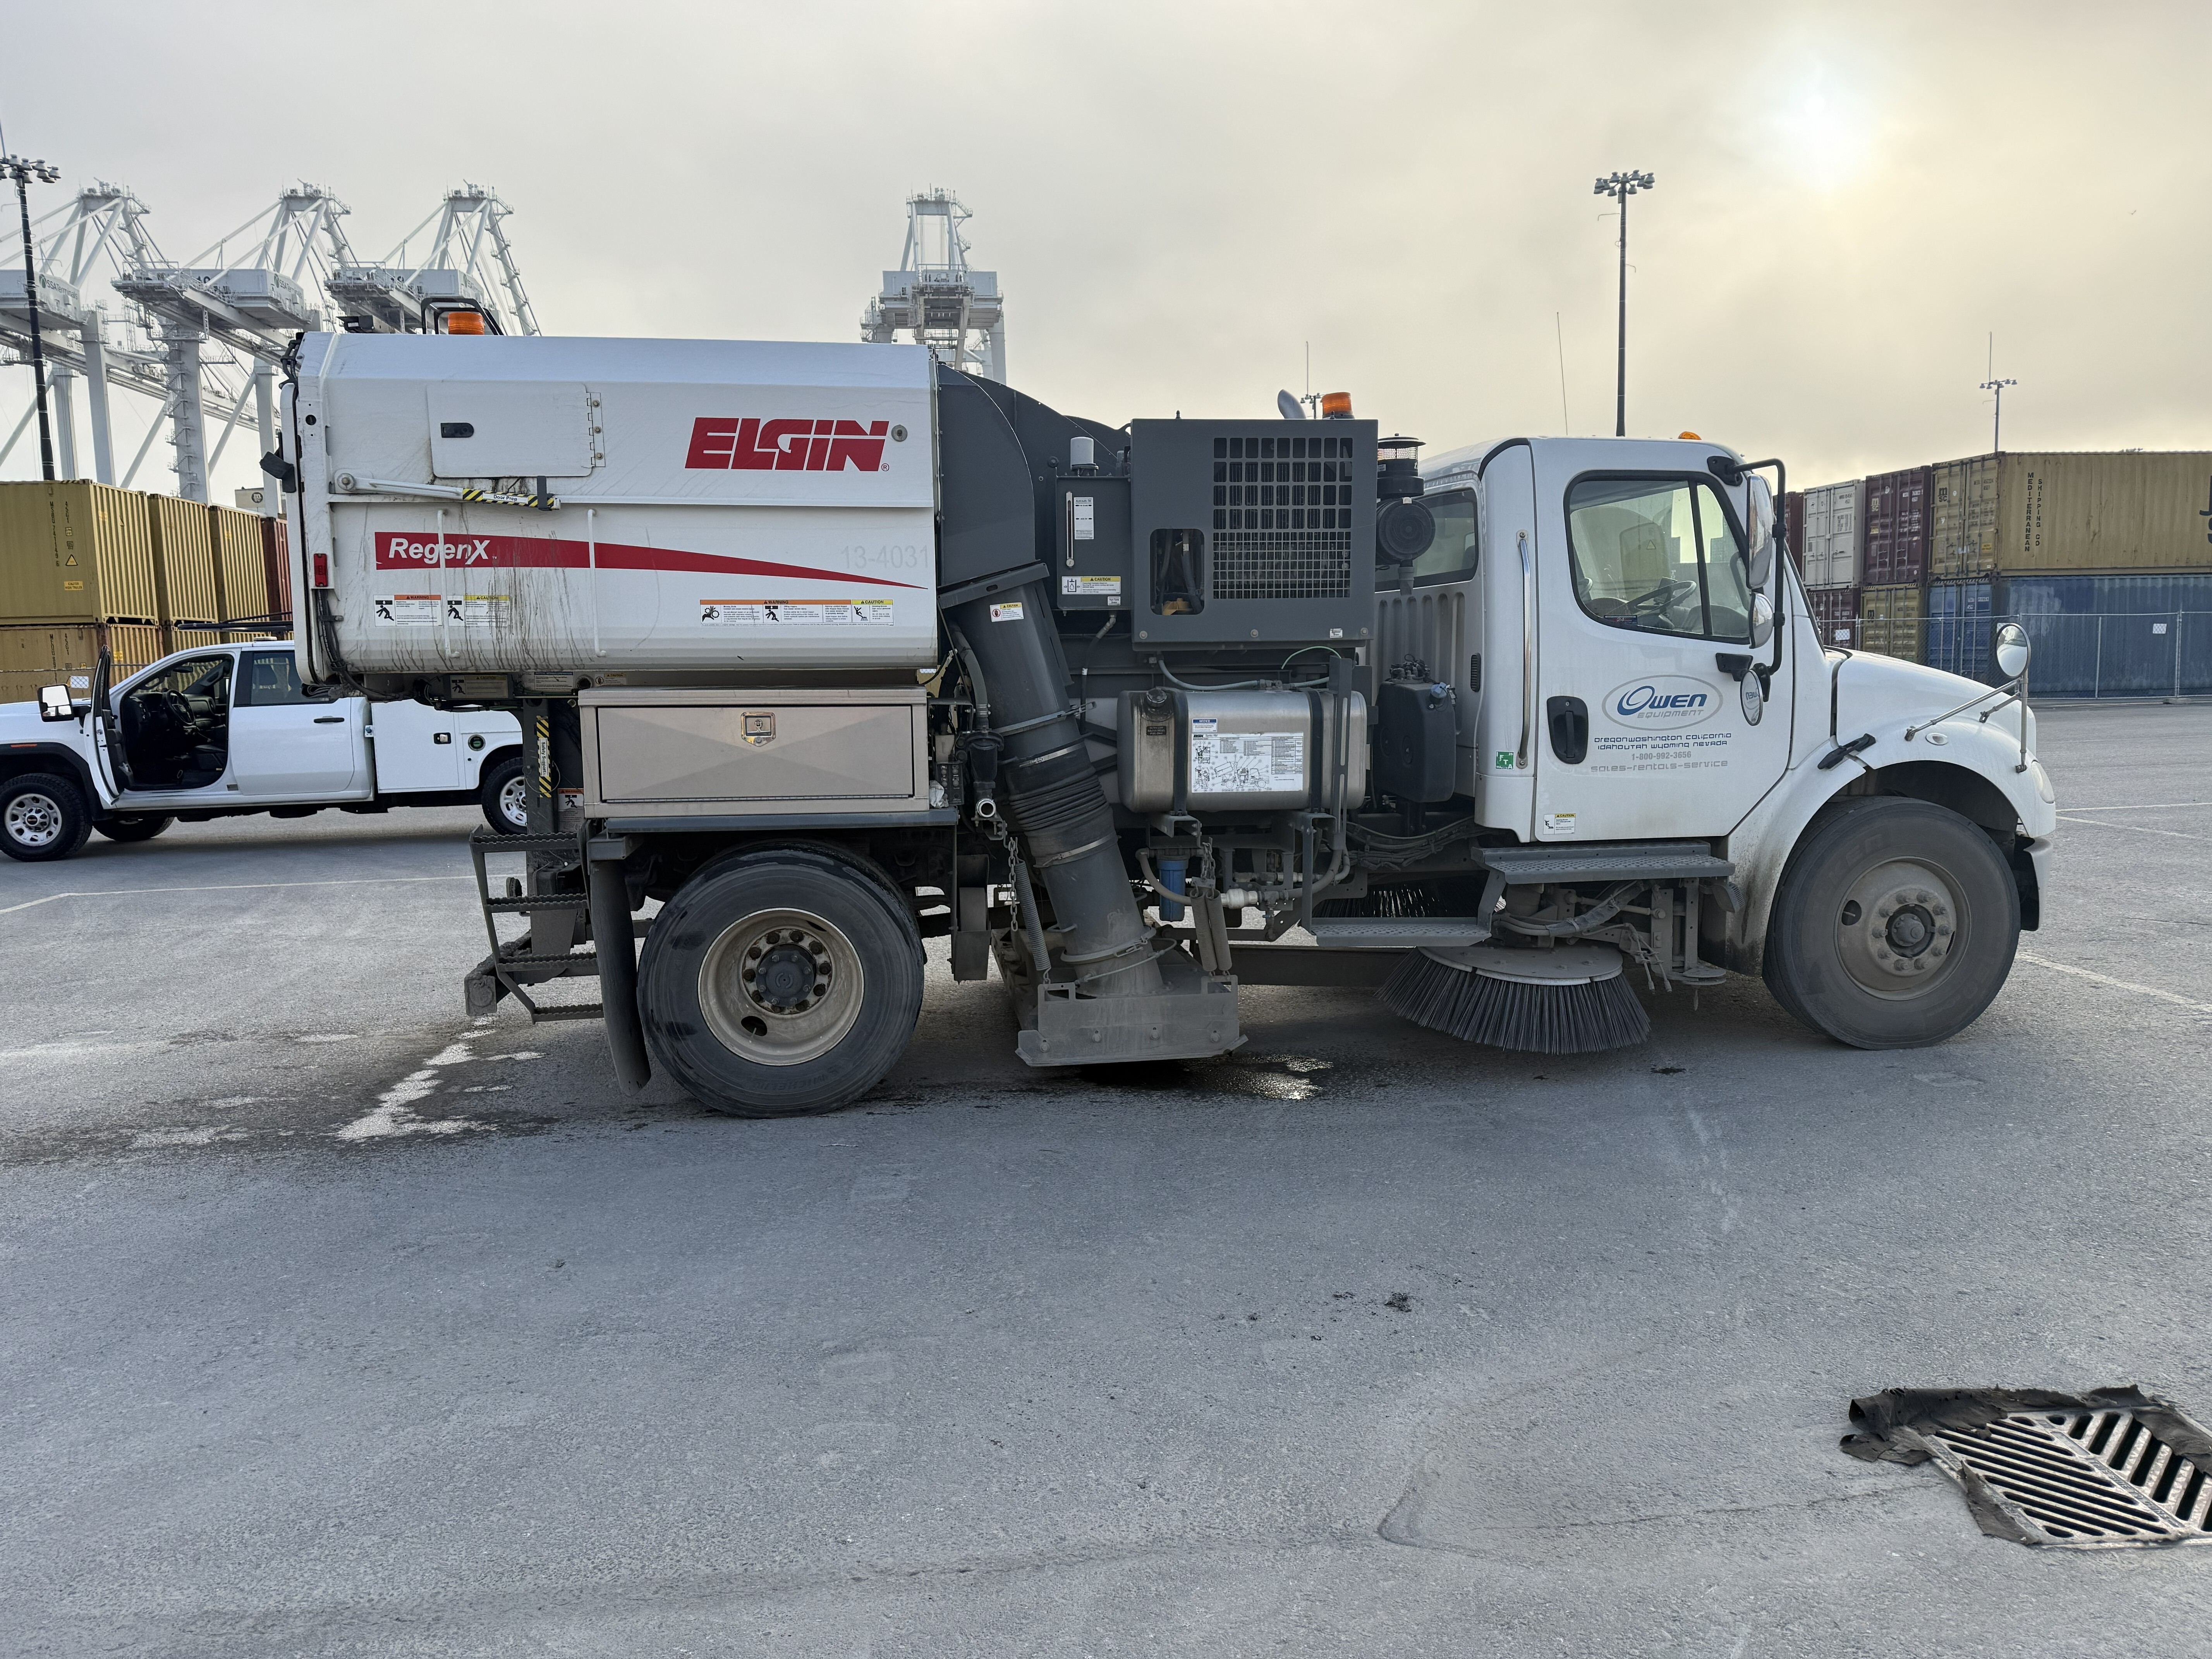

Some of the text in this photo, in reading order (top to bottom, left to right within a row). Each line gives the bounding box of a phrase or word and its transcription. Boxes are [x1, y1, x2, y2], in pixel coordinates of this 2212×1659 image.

[685, 417, 889, 471] ELGIN
[2025, 472, 2034, 552] MEDITERRANEAN
[388, 538, 491, 565] RegenX
[2035, 534, 2040, 546] CO
[840, 545, 928, 569] 13-4031
[1632, 751, 1692, 761] 1-800-992-3656
